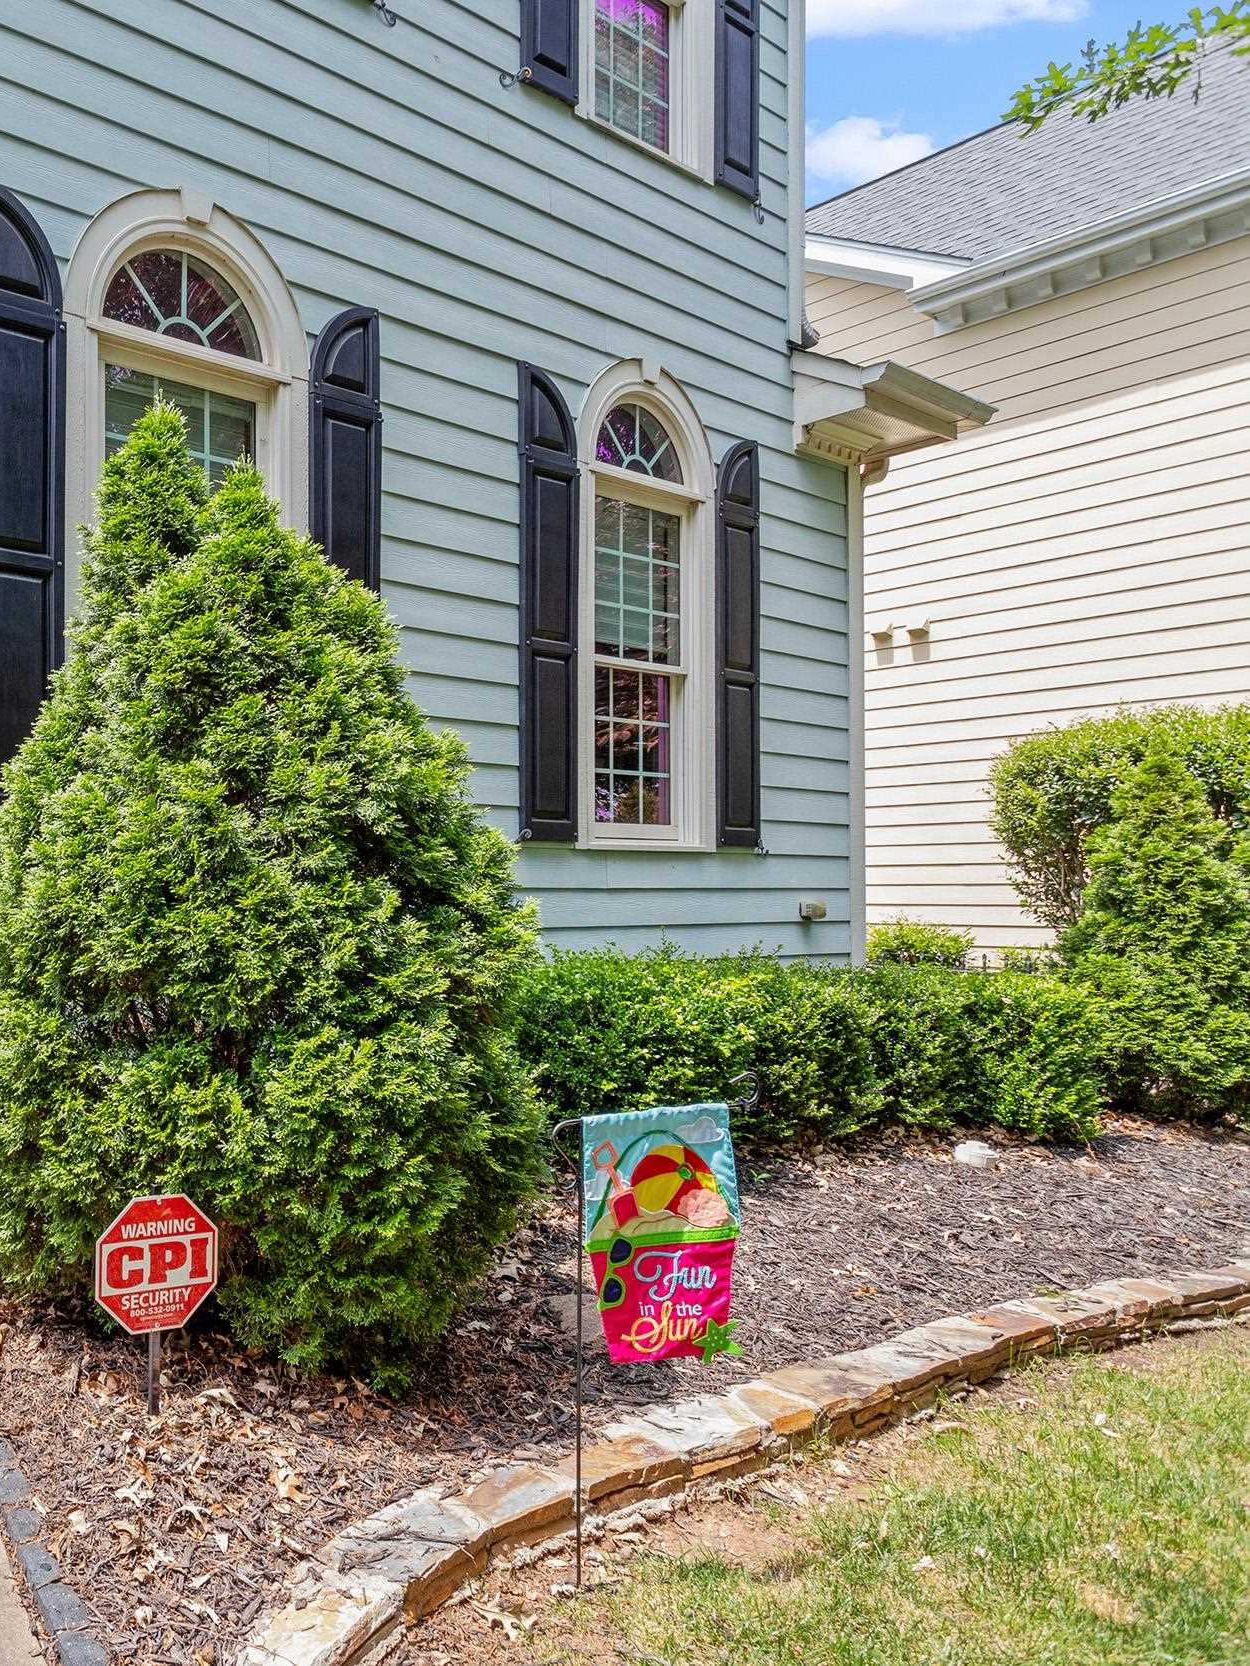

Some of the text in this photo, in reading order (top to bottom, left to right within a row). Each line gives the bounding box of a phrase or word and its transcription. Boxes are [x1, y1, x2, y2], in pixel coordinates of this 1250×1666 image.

[121, 1216, 196, 1240] WARNING
[106, 1237, 209, 1290] CPI
[634, 1250, 717, 1301] Fun
[121, 1286, 192, 1310] SECURITY
[130, 1302, 185, 1318] 800-532-0911
[639, 1302, 702, 1316] in the
[621, 1300, 704, 1353] Sun
